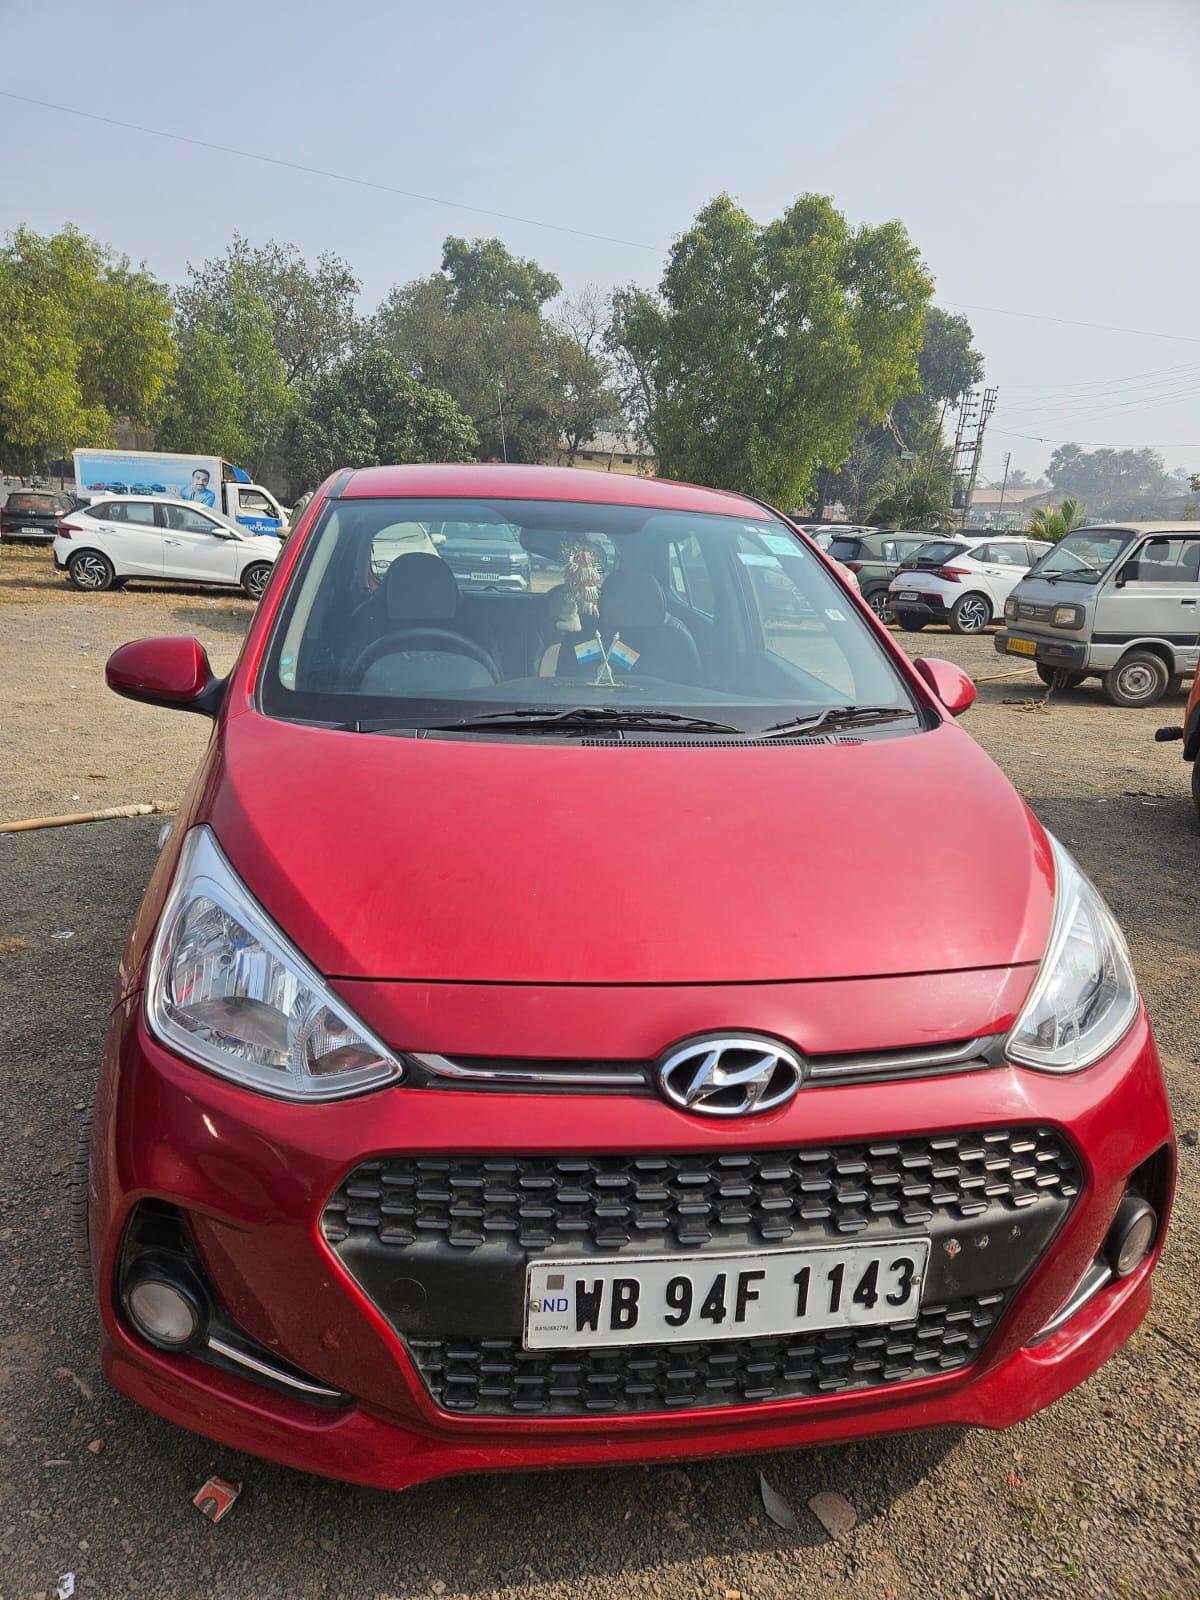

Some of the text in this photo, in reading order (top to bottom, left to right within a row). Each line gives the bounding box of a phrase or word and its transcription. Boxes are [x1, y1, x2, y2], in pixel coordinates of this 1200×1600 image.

[575, 1257, 915, 1332] WB 94F 1143
